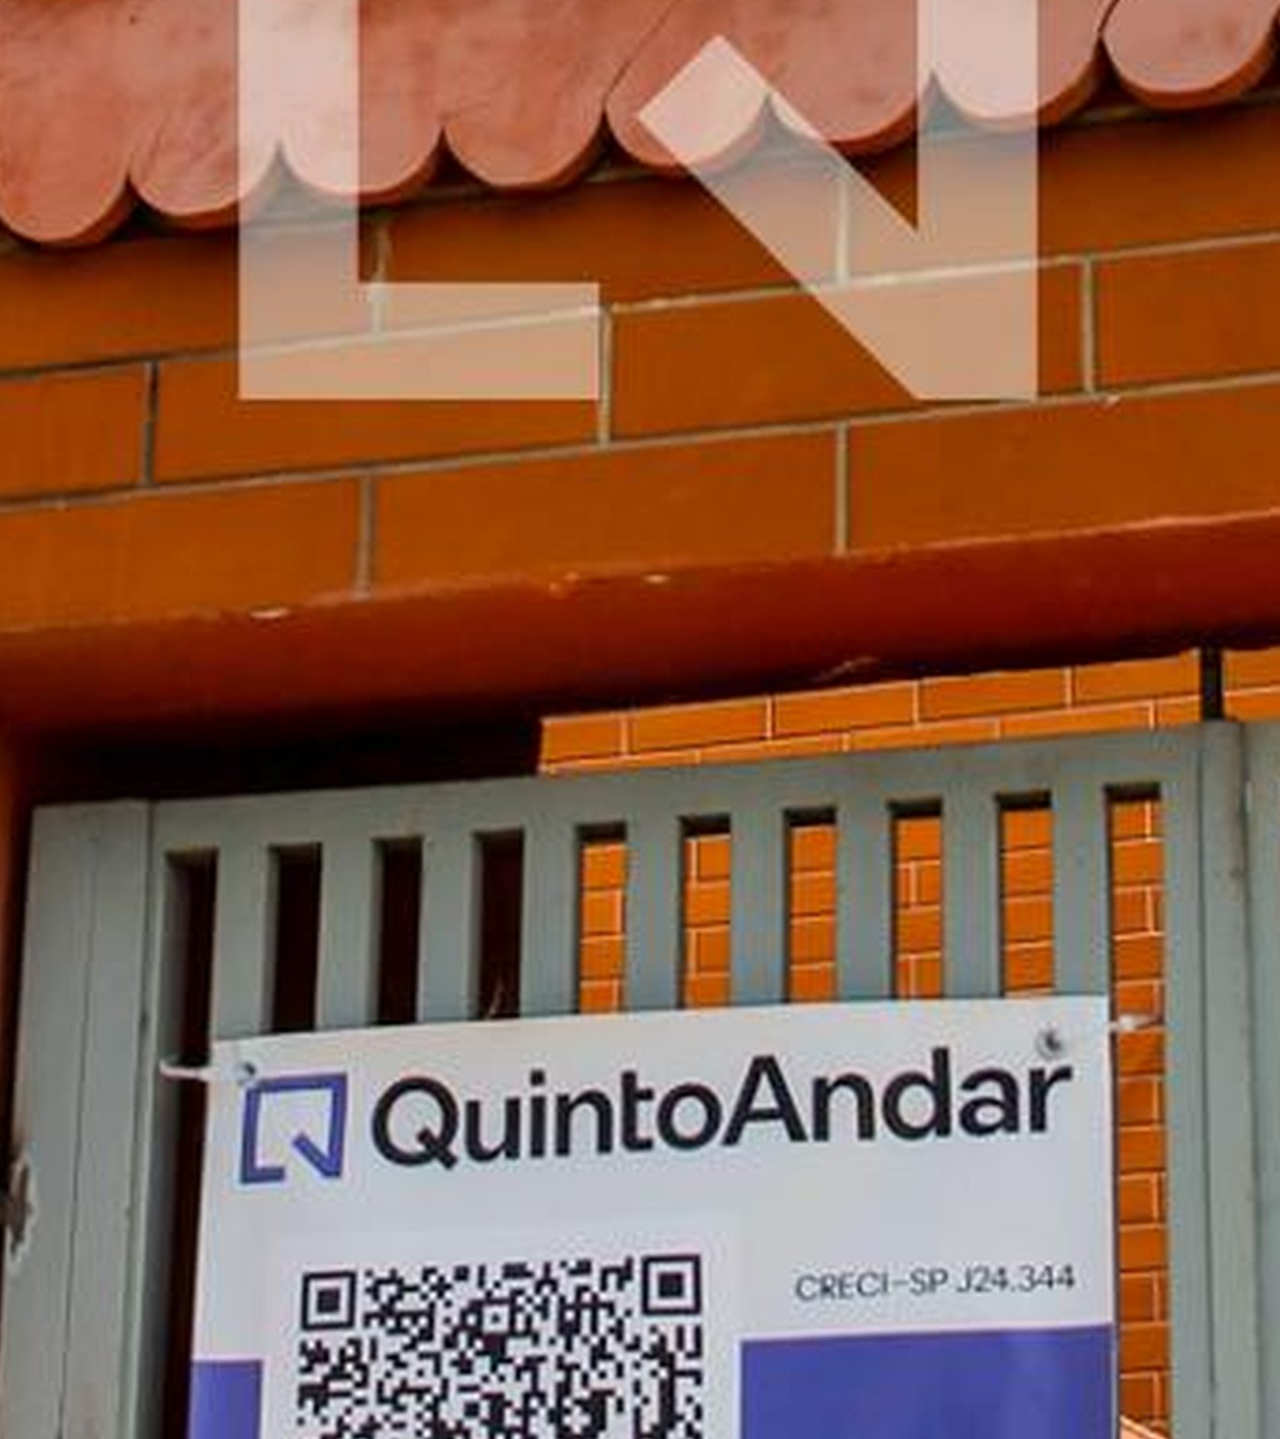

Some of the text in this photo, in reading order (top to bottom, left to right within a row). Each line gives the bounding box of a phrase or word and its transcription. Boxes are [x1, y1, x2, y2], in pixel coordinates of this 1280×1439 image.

[371, 1046, 1073, 1170] QuintoAndar
[794, 1263, 1076, 1302] CRECI-SP J24.344
